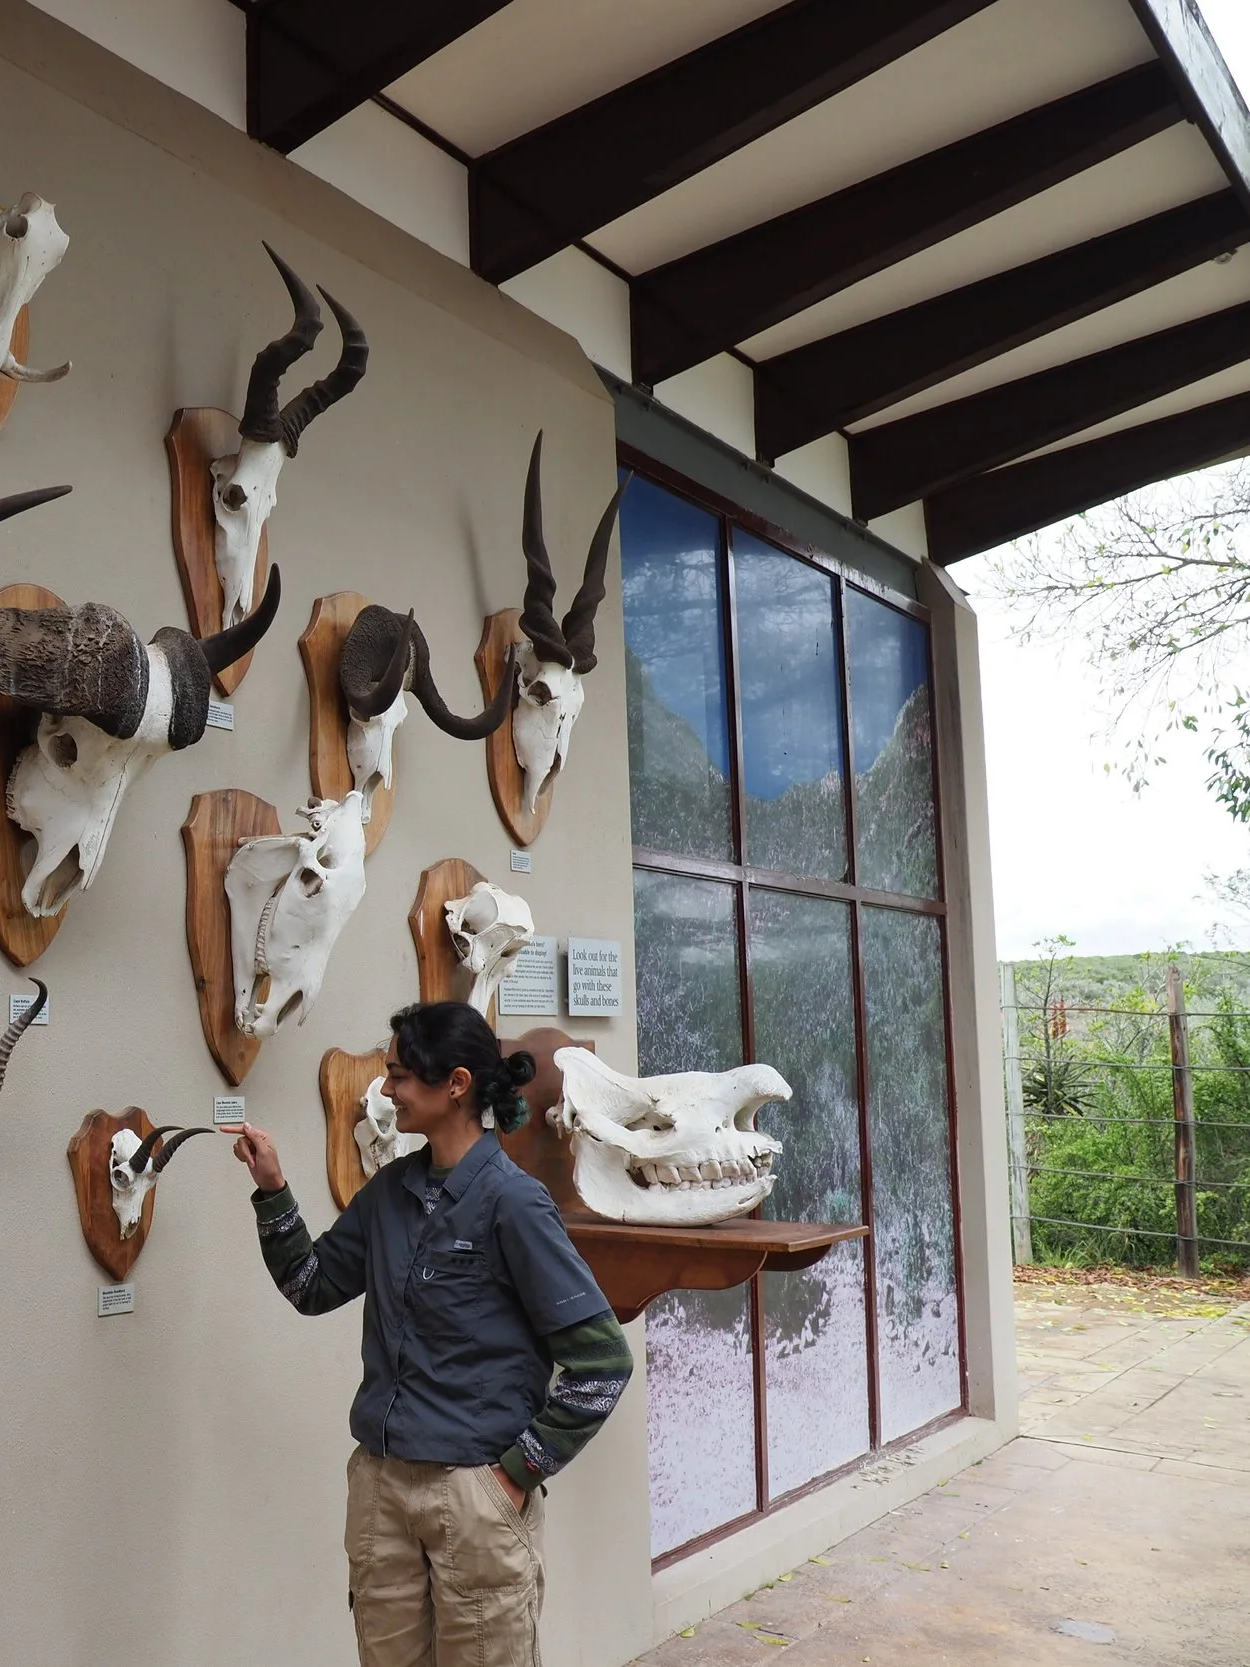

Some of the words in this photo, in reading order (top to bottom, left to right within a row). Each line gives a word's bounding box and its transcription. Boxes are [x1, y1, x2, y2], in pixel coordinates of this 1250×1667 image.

[573, 949, 587, 960] Look
[588, 952, 598, 961] out
[599, 949, 607, 961] for
[608, 950, 617, 962] the
[573, 963, 583, 975] live
[584, 965, 606, 976] animals
[607, 965, 618, 977] that
[573, 982, 580, 993] go
[582, 979, 595, 990] with
[597, 980, 612, 991] these
[574, 994, 589, 1006] skulls
[590, 995, 601, 1006] and
[601, 995, 618, 1006] bones
